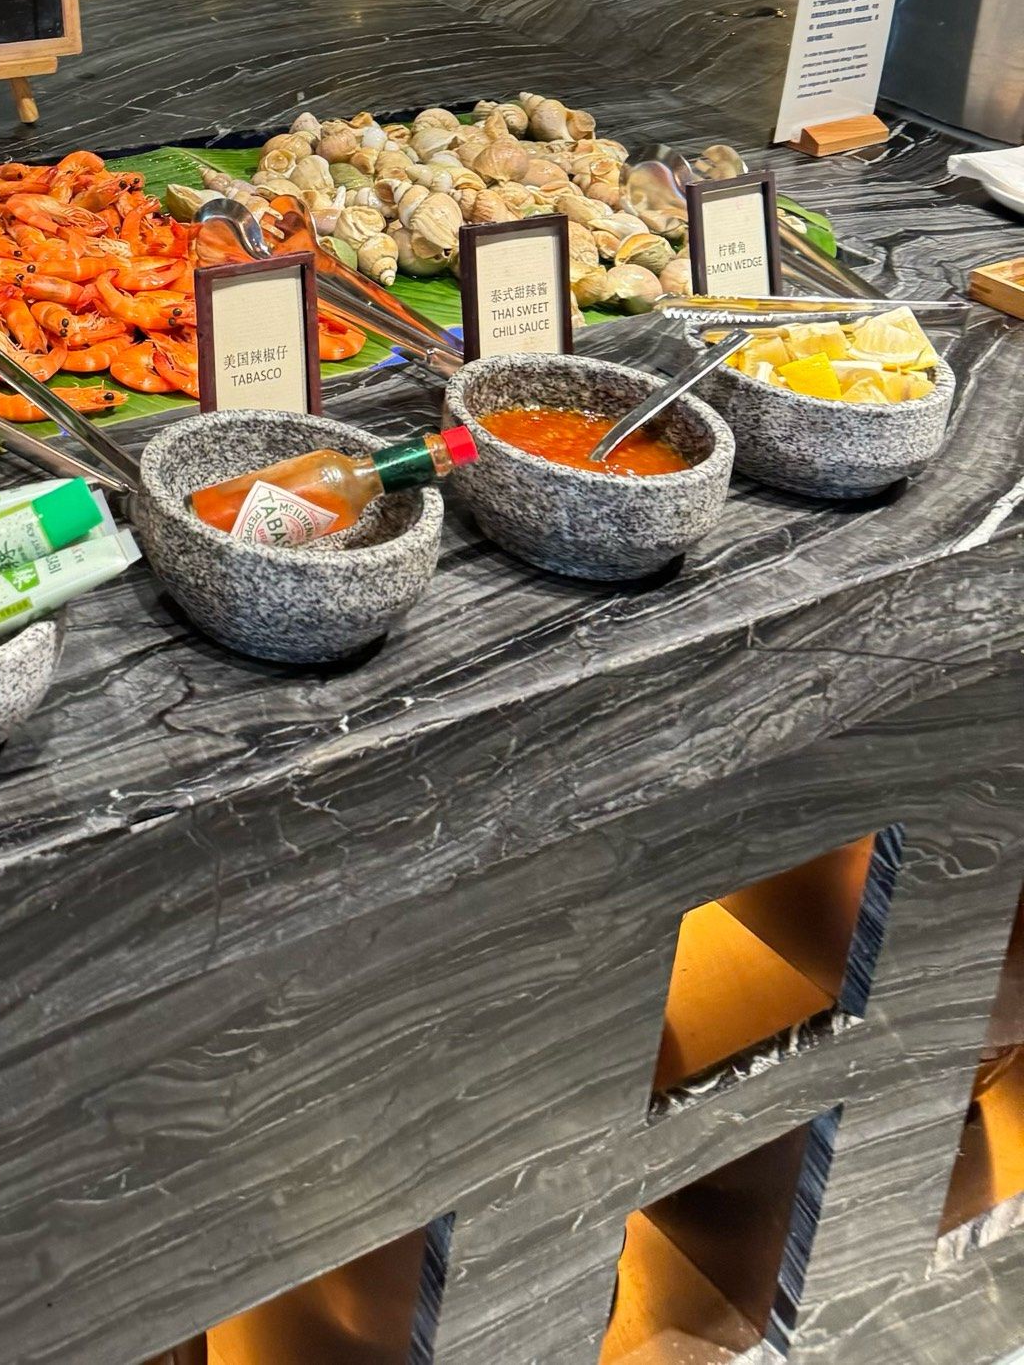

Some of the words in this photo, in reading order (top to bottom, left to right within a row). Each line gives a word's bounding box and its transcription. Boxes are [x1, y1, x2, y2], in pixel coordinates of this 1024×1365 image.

[719, 241, 746, 257] 柠檬角
[707, 262, 733, 275] EMON
[733, 256, 763, 271] WEDGE
[491, 282, 548, 304] 泰式甜辣酱
[492, 306, 515, 321] THAI
[517, 301, 549, 317] SWEET
[493, 324, 517, 338] CHILI
[519, 319, 550, 335] SAUCE
[224, 345, 288, 371] 美国辣椒仔
[231, 367, 282, 387] TABASCO
[243, 510, 262, 544] PEPPE
[257, 491, 292, 548] TABAS
